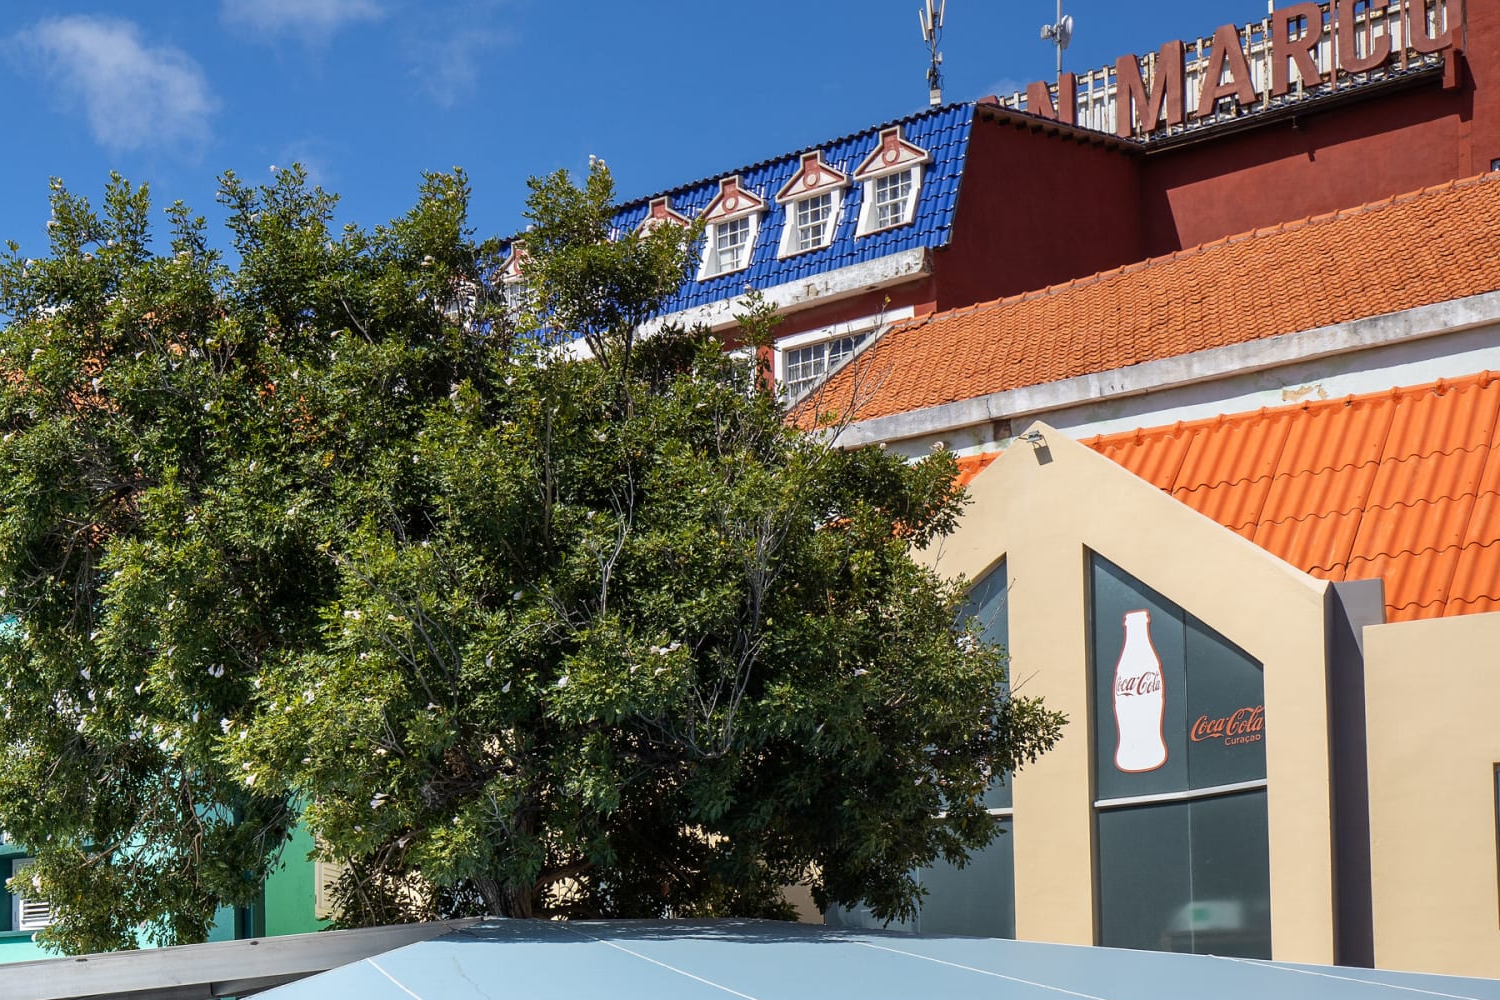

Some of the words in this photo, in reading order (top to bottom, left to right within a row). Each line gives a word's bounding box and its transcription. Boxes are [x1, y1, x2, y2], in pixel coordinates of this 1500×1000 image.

[1115, 0, 1466, 138] MARCO
[1190, 705, 1265, 743] Coca-Cola
[1225, 733, 1262, 746] Curaçao
